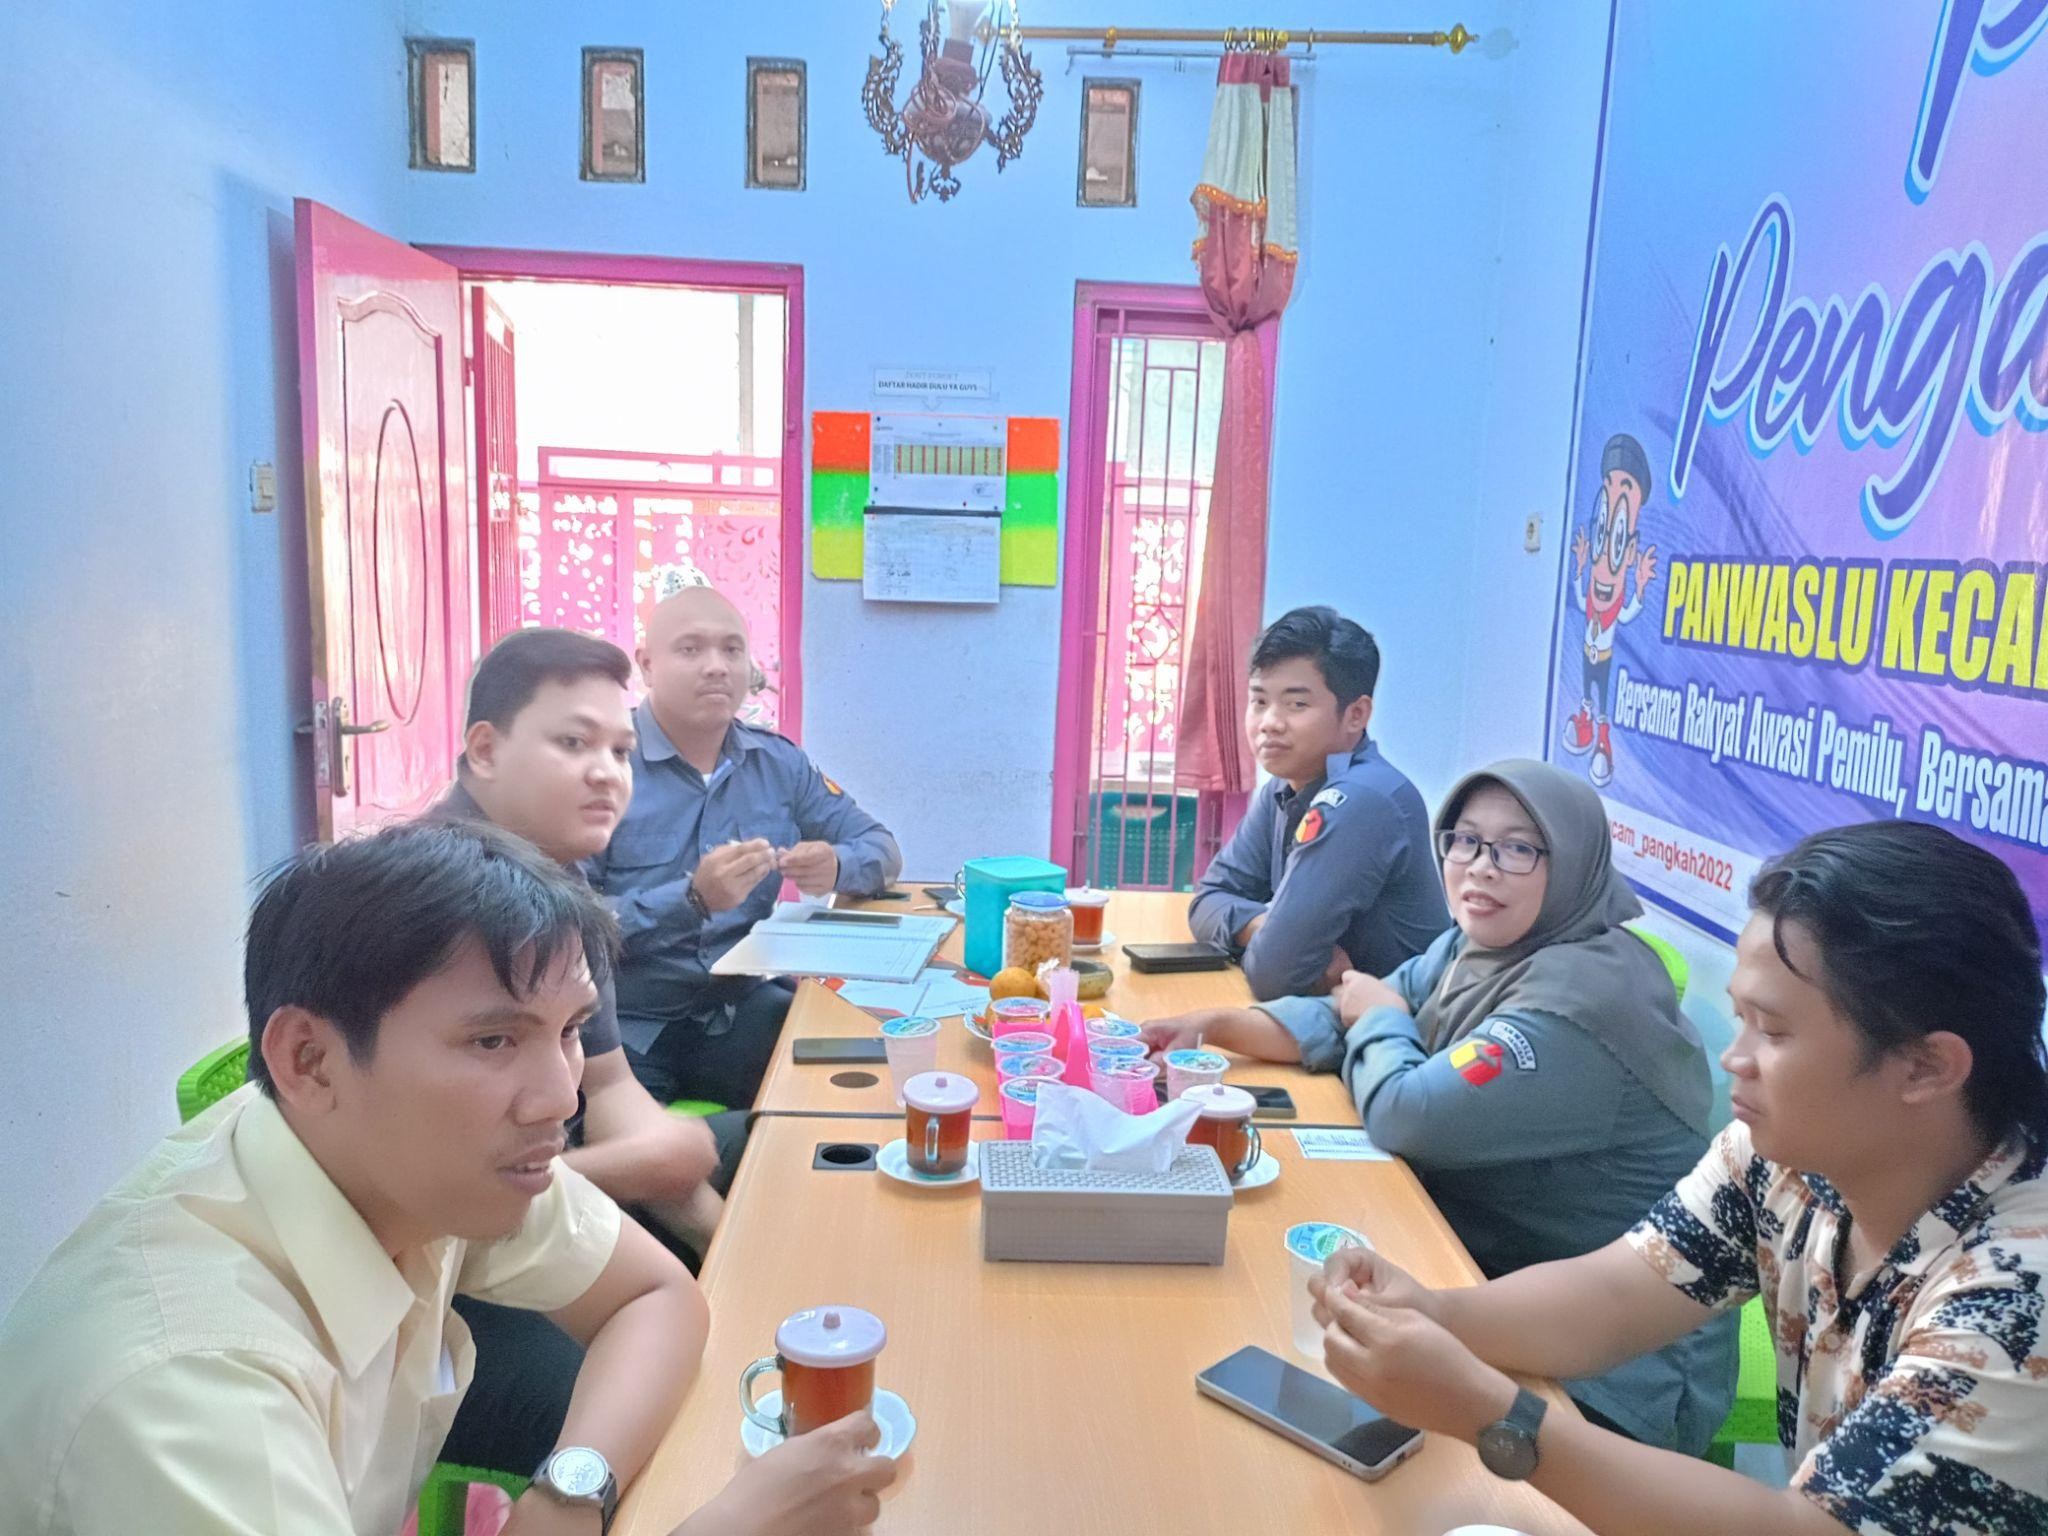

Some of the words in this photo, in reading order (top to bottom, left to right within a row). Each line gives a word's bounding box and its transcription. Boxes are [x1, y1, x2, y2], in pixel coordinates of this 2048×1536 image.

[879, 380, 906, 389] DAFTAR
[906, 382, 928, 390] HADIR
[1664, 562, 1877, 665] PANWASLU
[1614, 667, 1682, 741] Bersama
[1682, 682, 1745, 764] Rakyat
[1745, 696, 1816, 778] Awasi
[1815, 709, 1907, 818] Pemilu,
